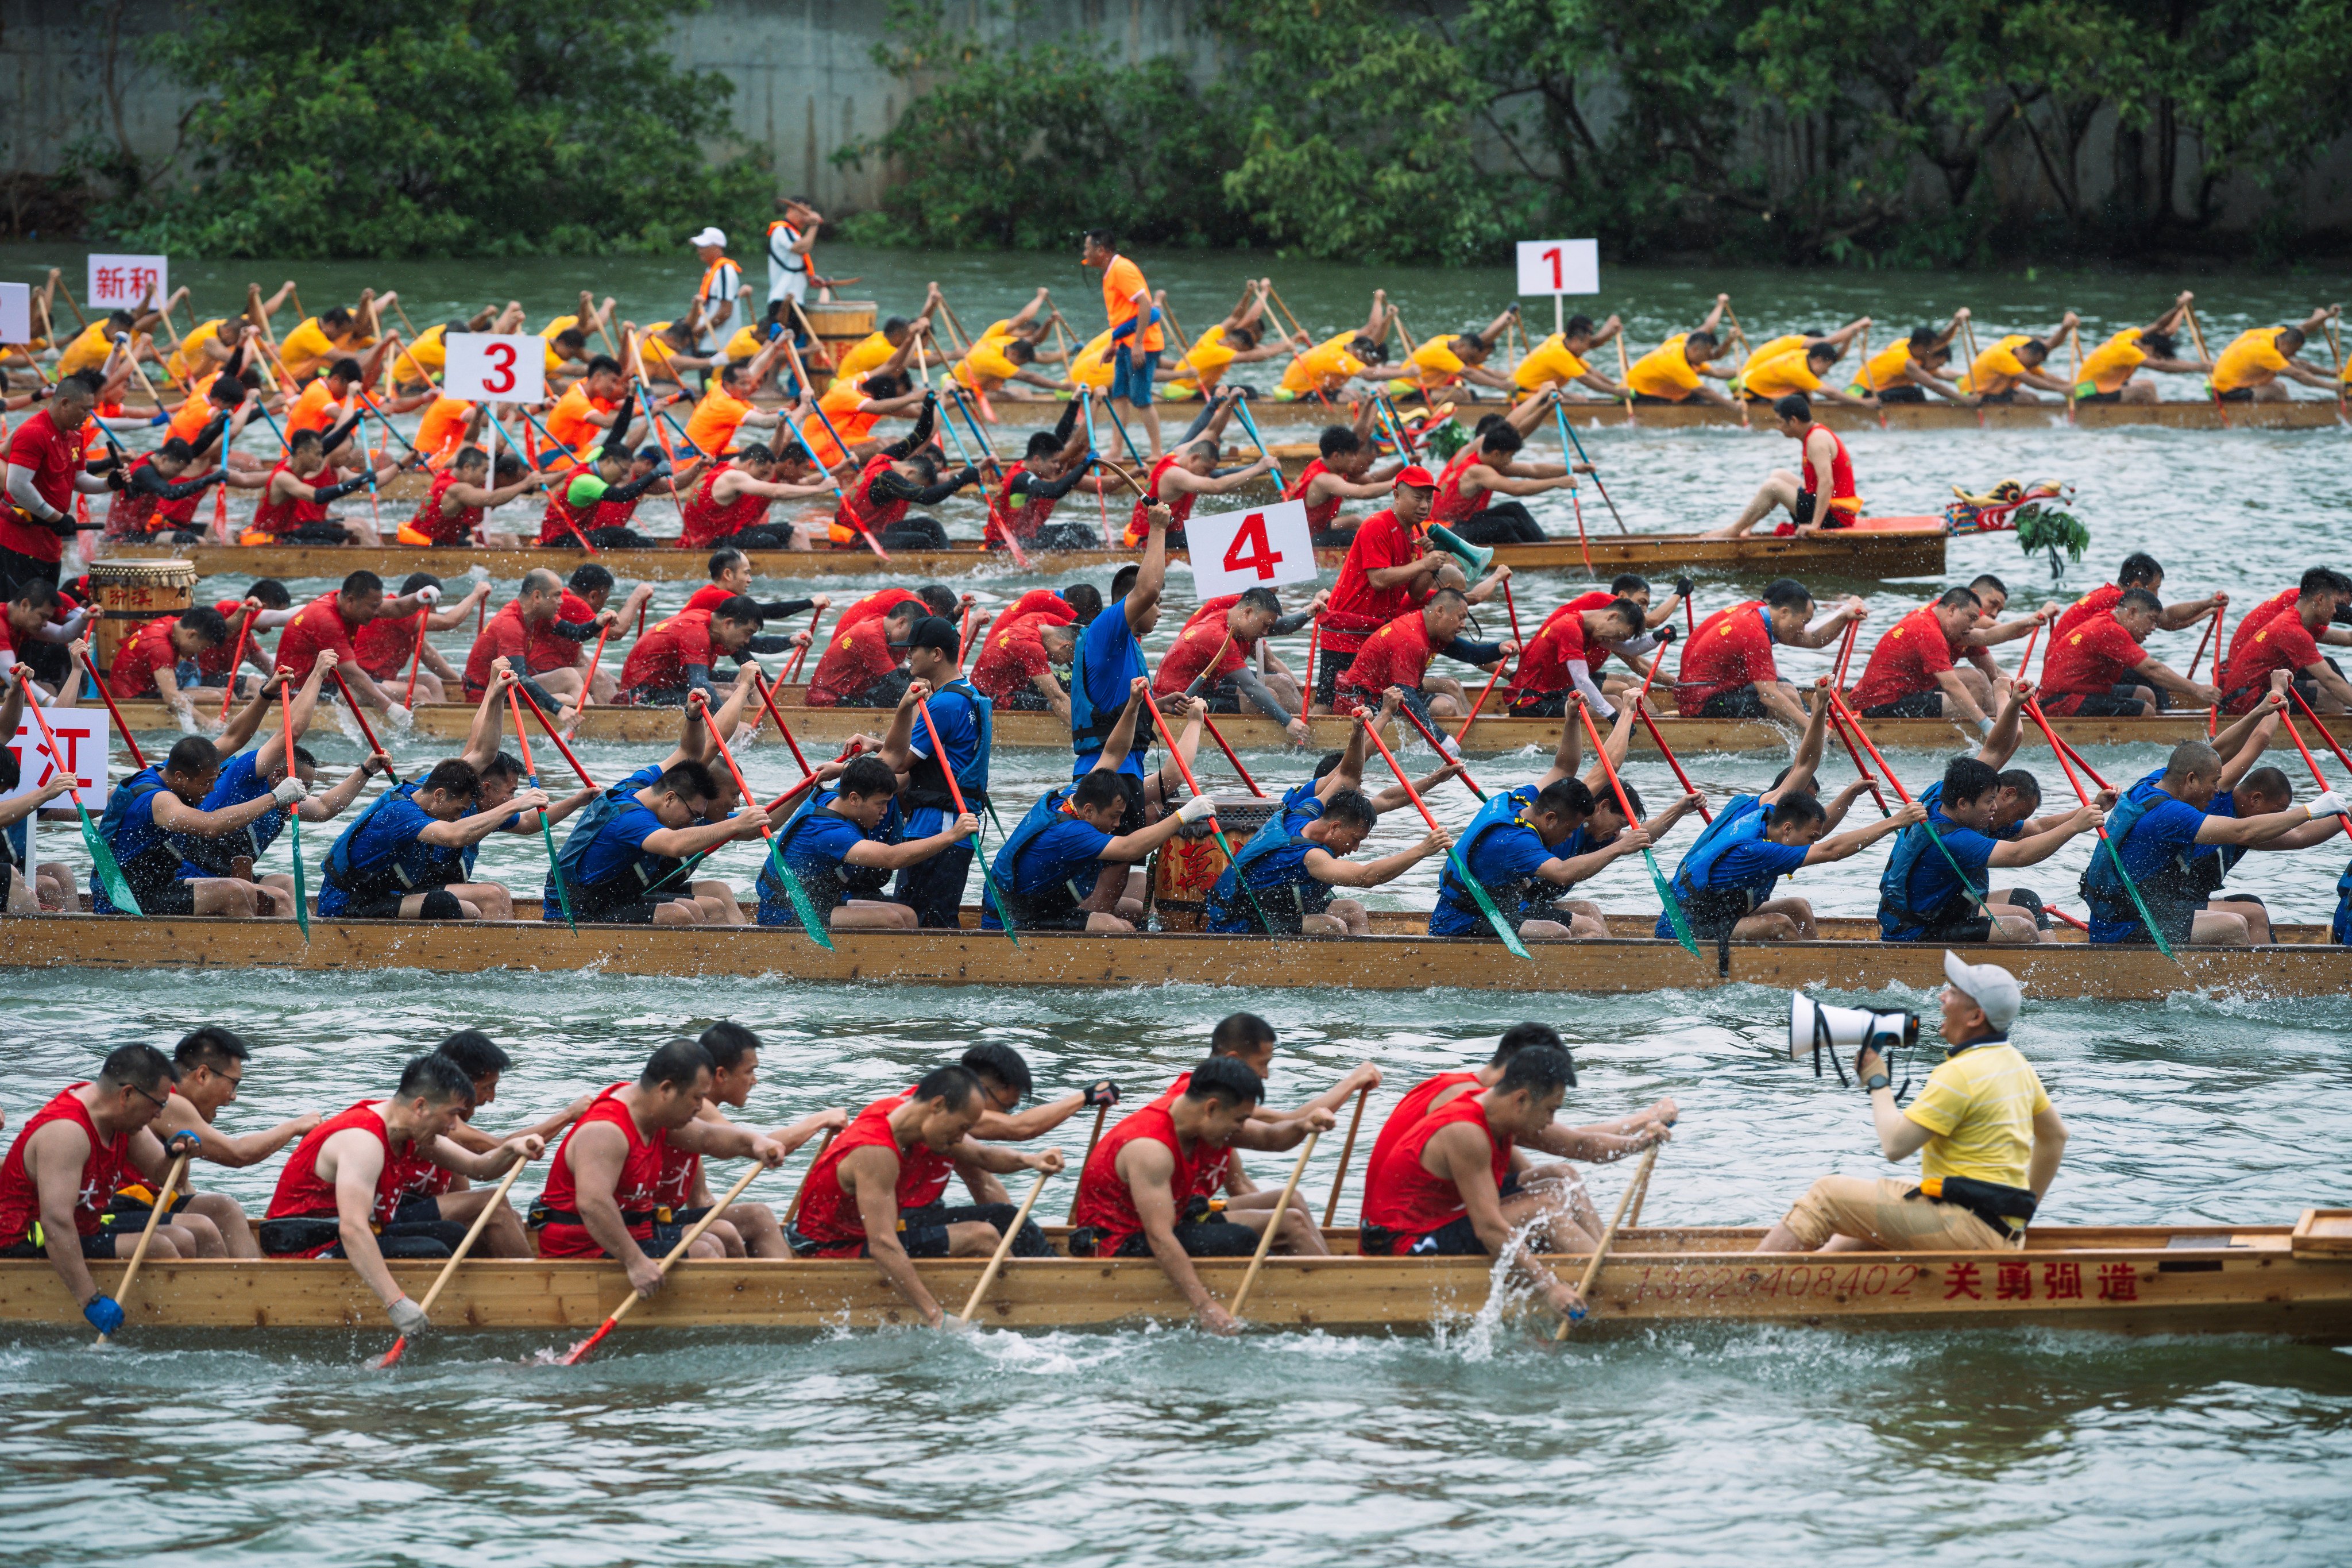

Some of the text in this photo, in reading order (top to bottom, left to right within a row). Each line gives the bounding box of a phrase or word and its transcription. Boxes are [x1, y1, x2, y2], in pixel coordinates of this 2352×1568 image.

[96, 266, 157, 299] 新和
[1542, 248, 1562, 289] 1
[482, 342, 516, 393] 3
[1223, 512, 1283, 581] 4
[1944, 1262, 2138, 1301] 关勇强造
